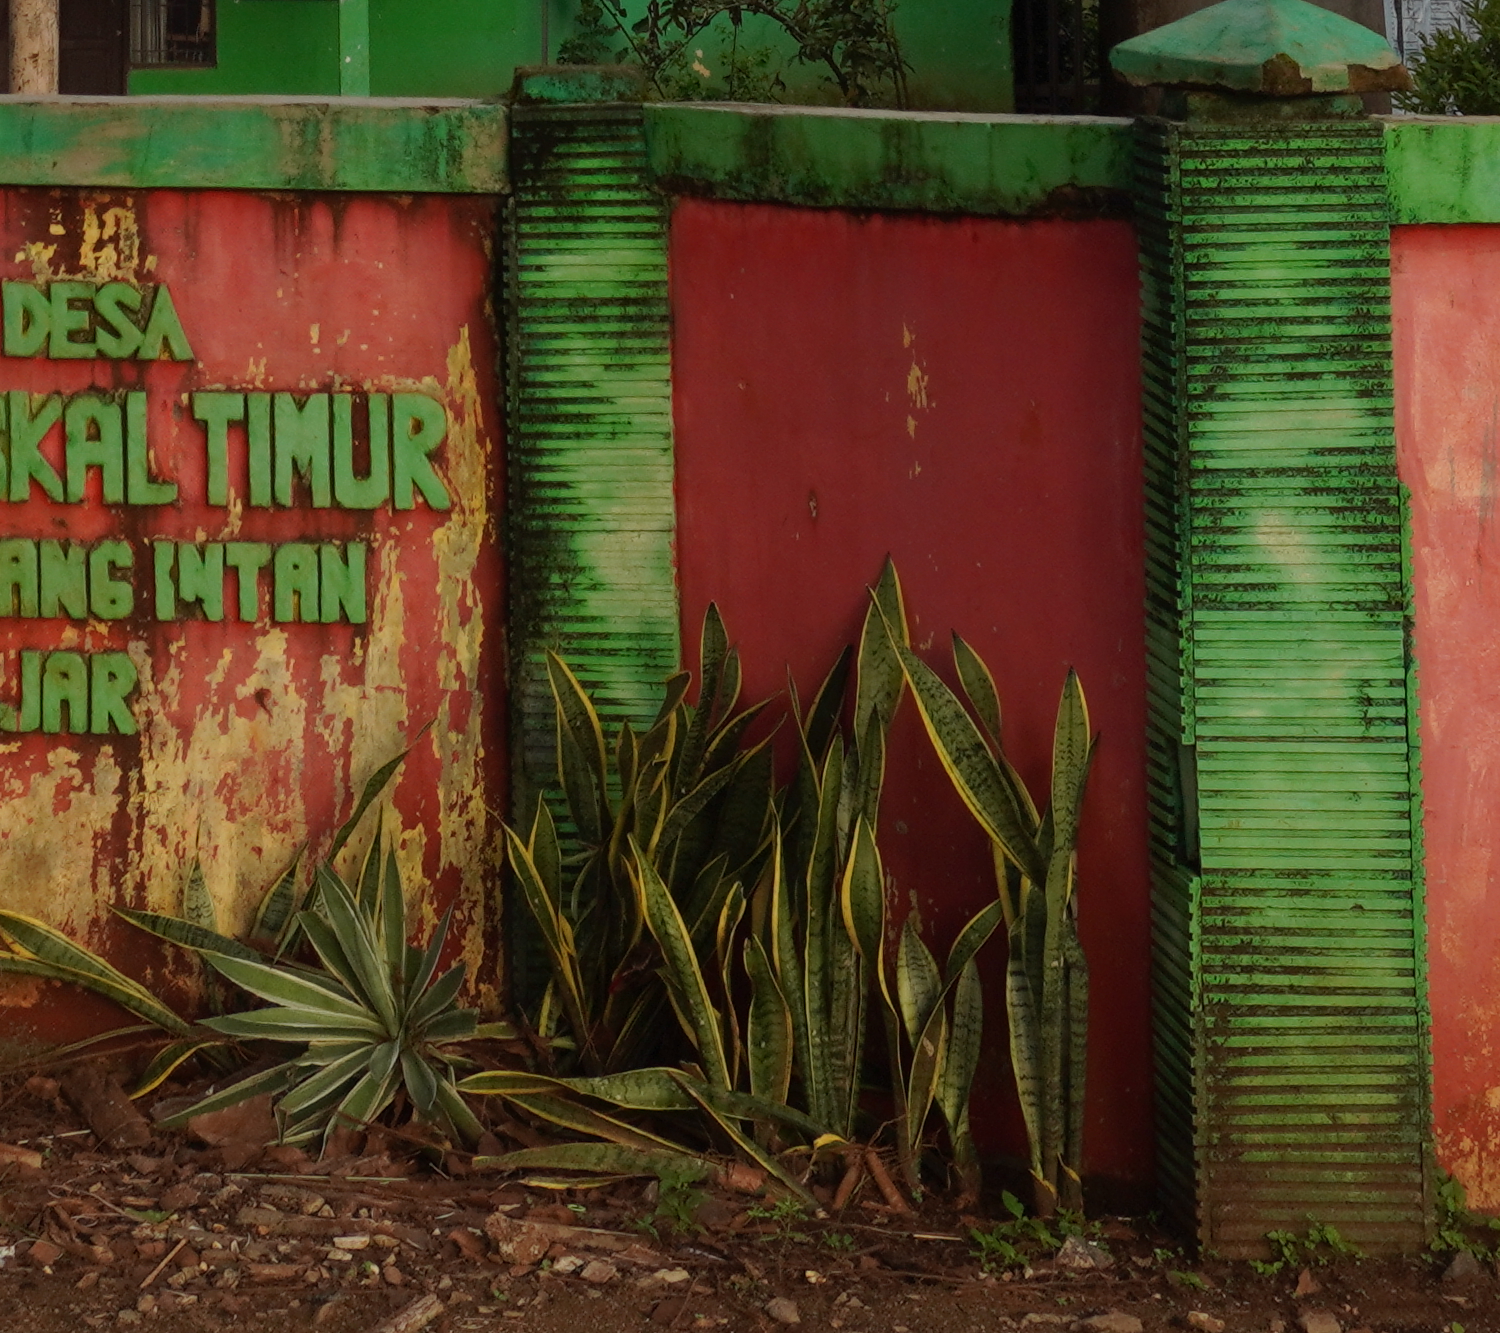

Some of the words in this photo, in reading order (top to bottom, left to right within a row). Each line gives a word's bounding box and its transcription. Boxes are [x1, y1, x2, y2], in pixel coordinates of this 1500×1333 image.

[1, 280, 195, 362] DESA
[190, 389, 450, 512] TIMUR
[152, 539, 369, 624] INTAN
